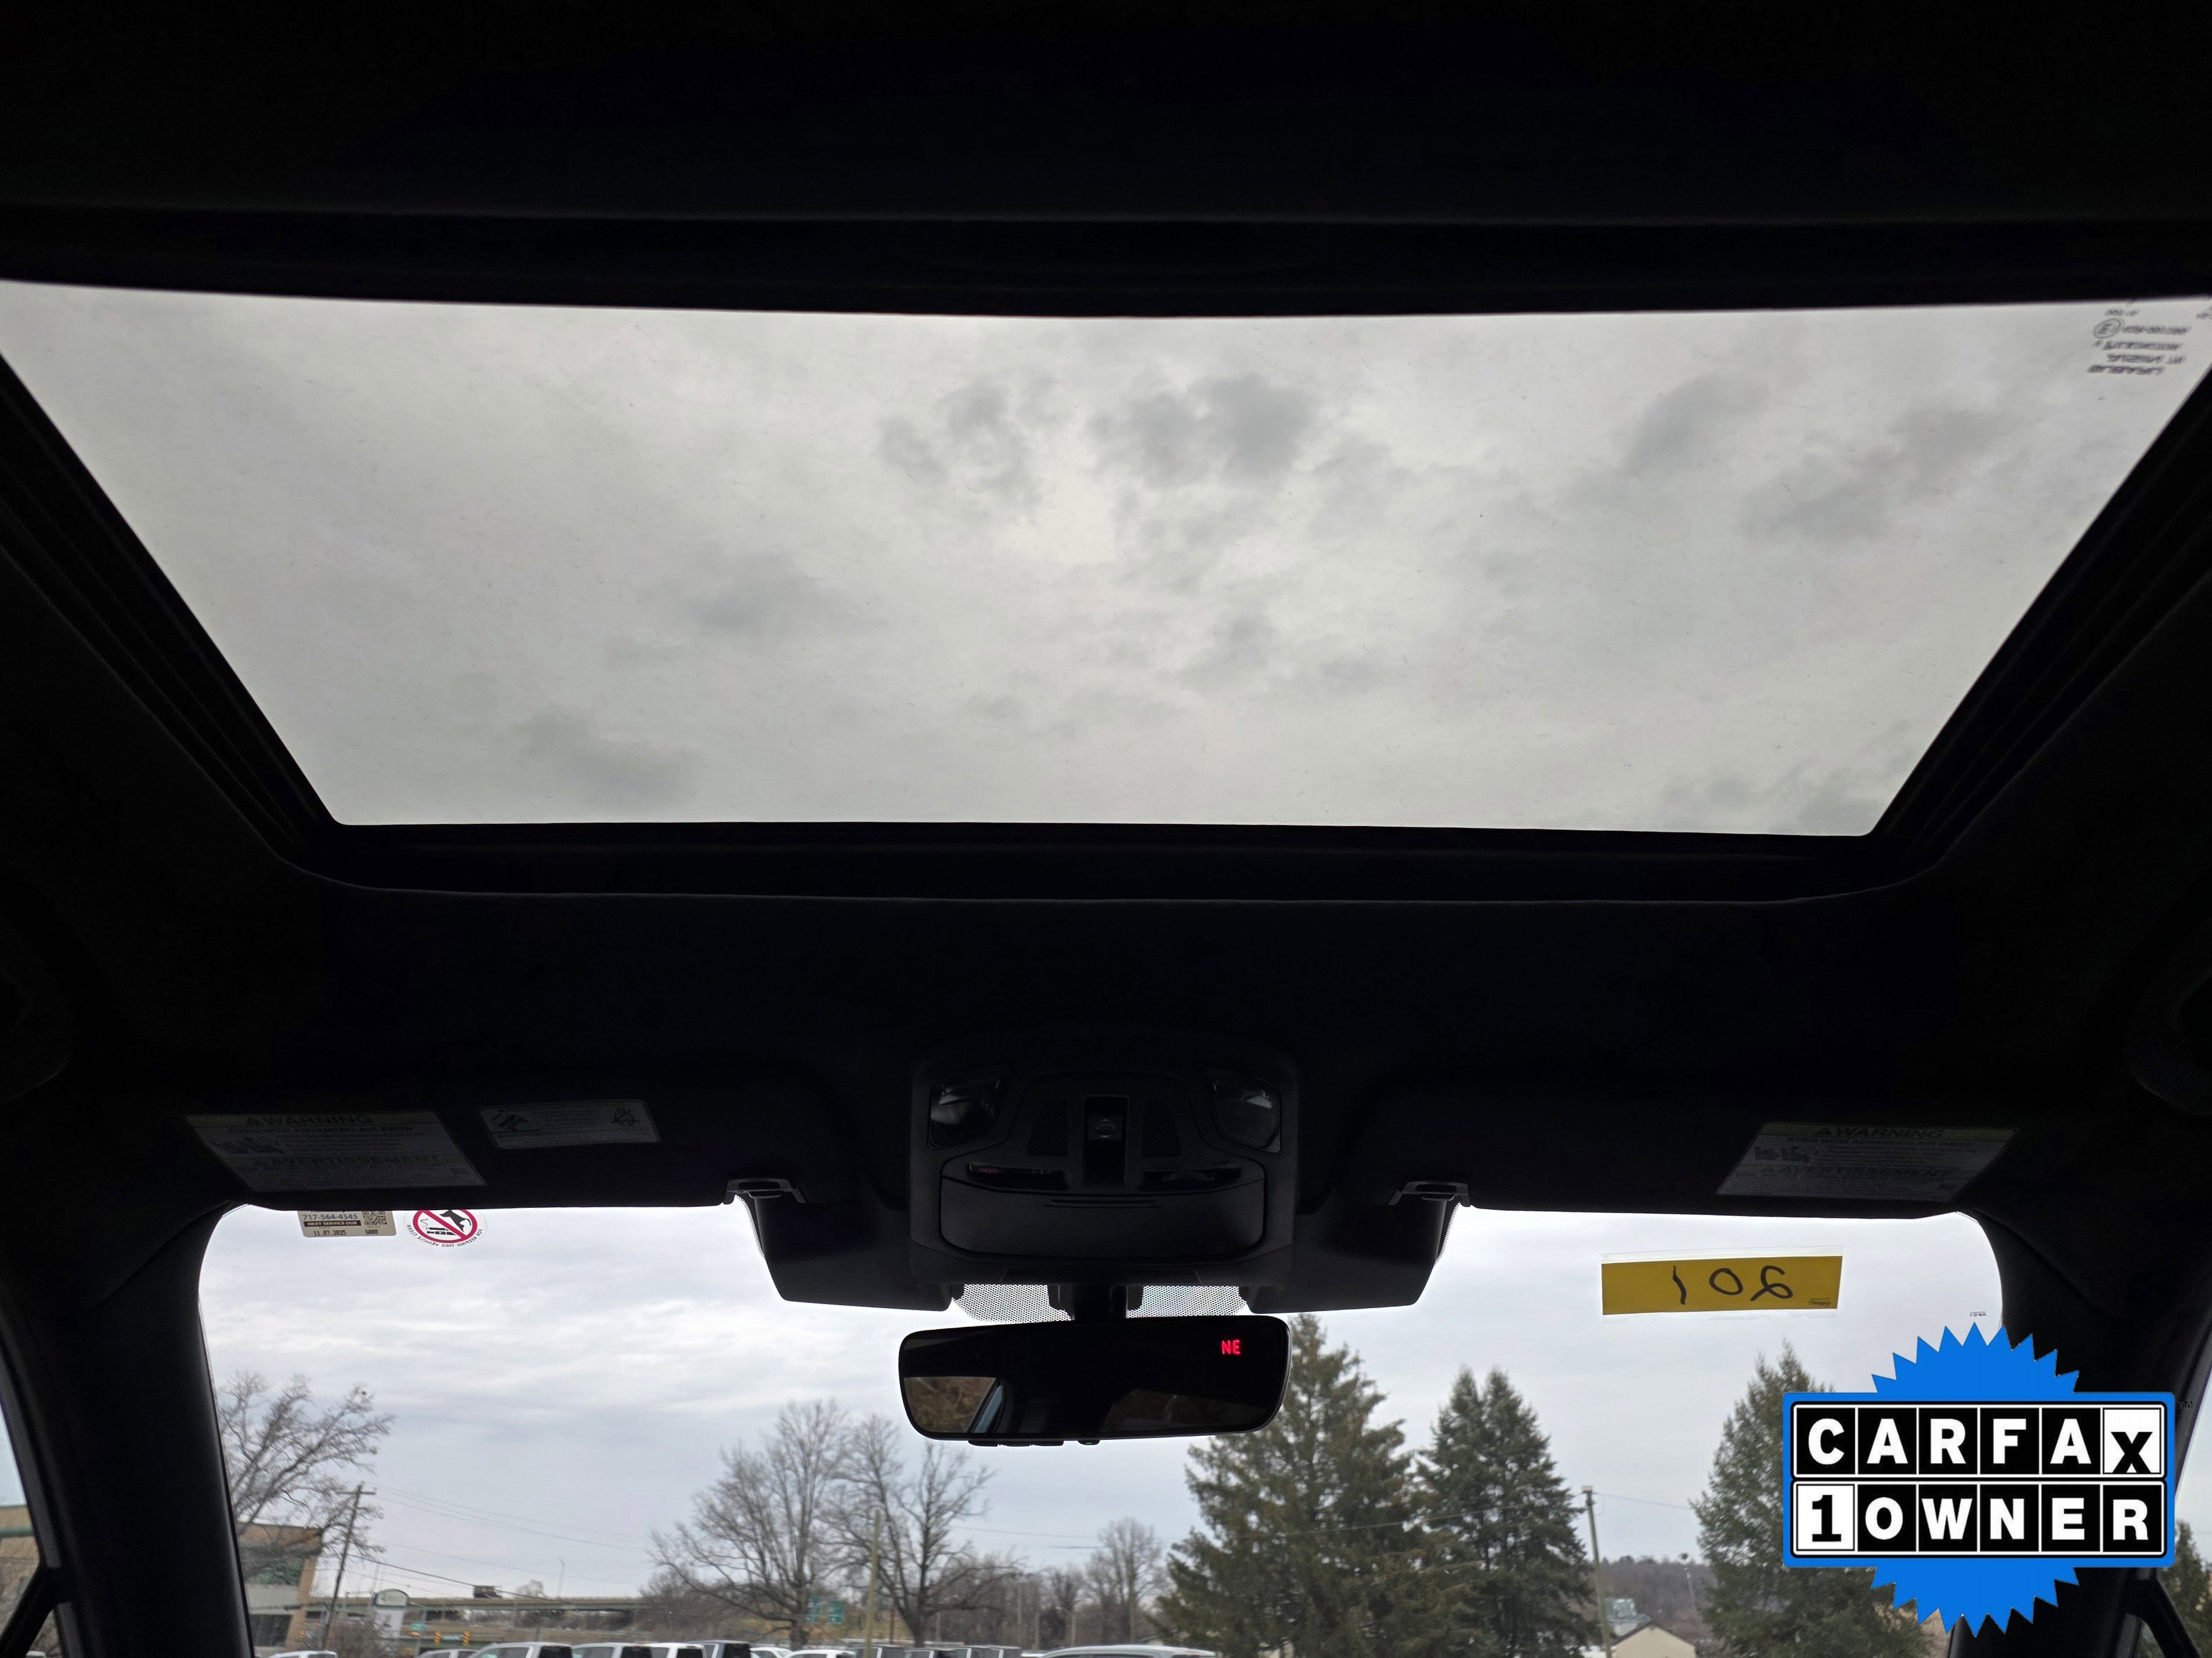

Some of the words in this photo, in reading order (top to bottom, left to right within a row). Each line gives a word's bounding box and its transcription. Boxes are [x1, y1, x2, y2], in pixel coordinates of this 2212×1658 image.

[262, 1114, 373, 1125] WARNING
[1837, 1127, 1943, 1138] WARNING
[270, 1155, 439, 1166] AVERTISSEMENT
[1778, 1166, 1951, 1177] AVERTISSEMENT
[1221, 1340, 1240, 1355] NE
